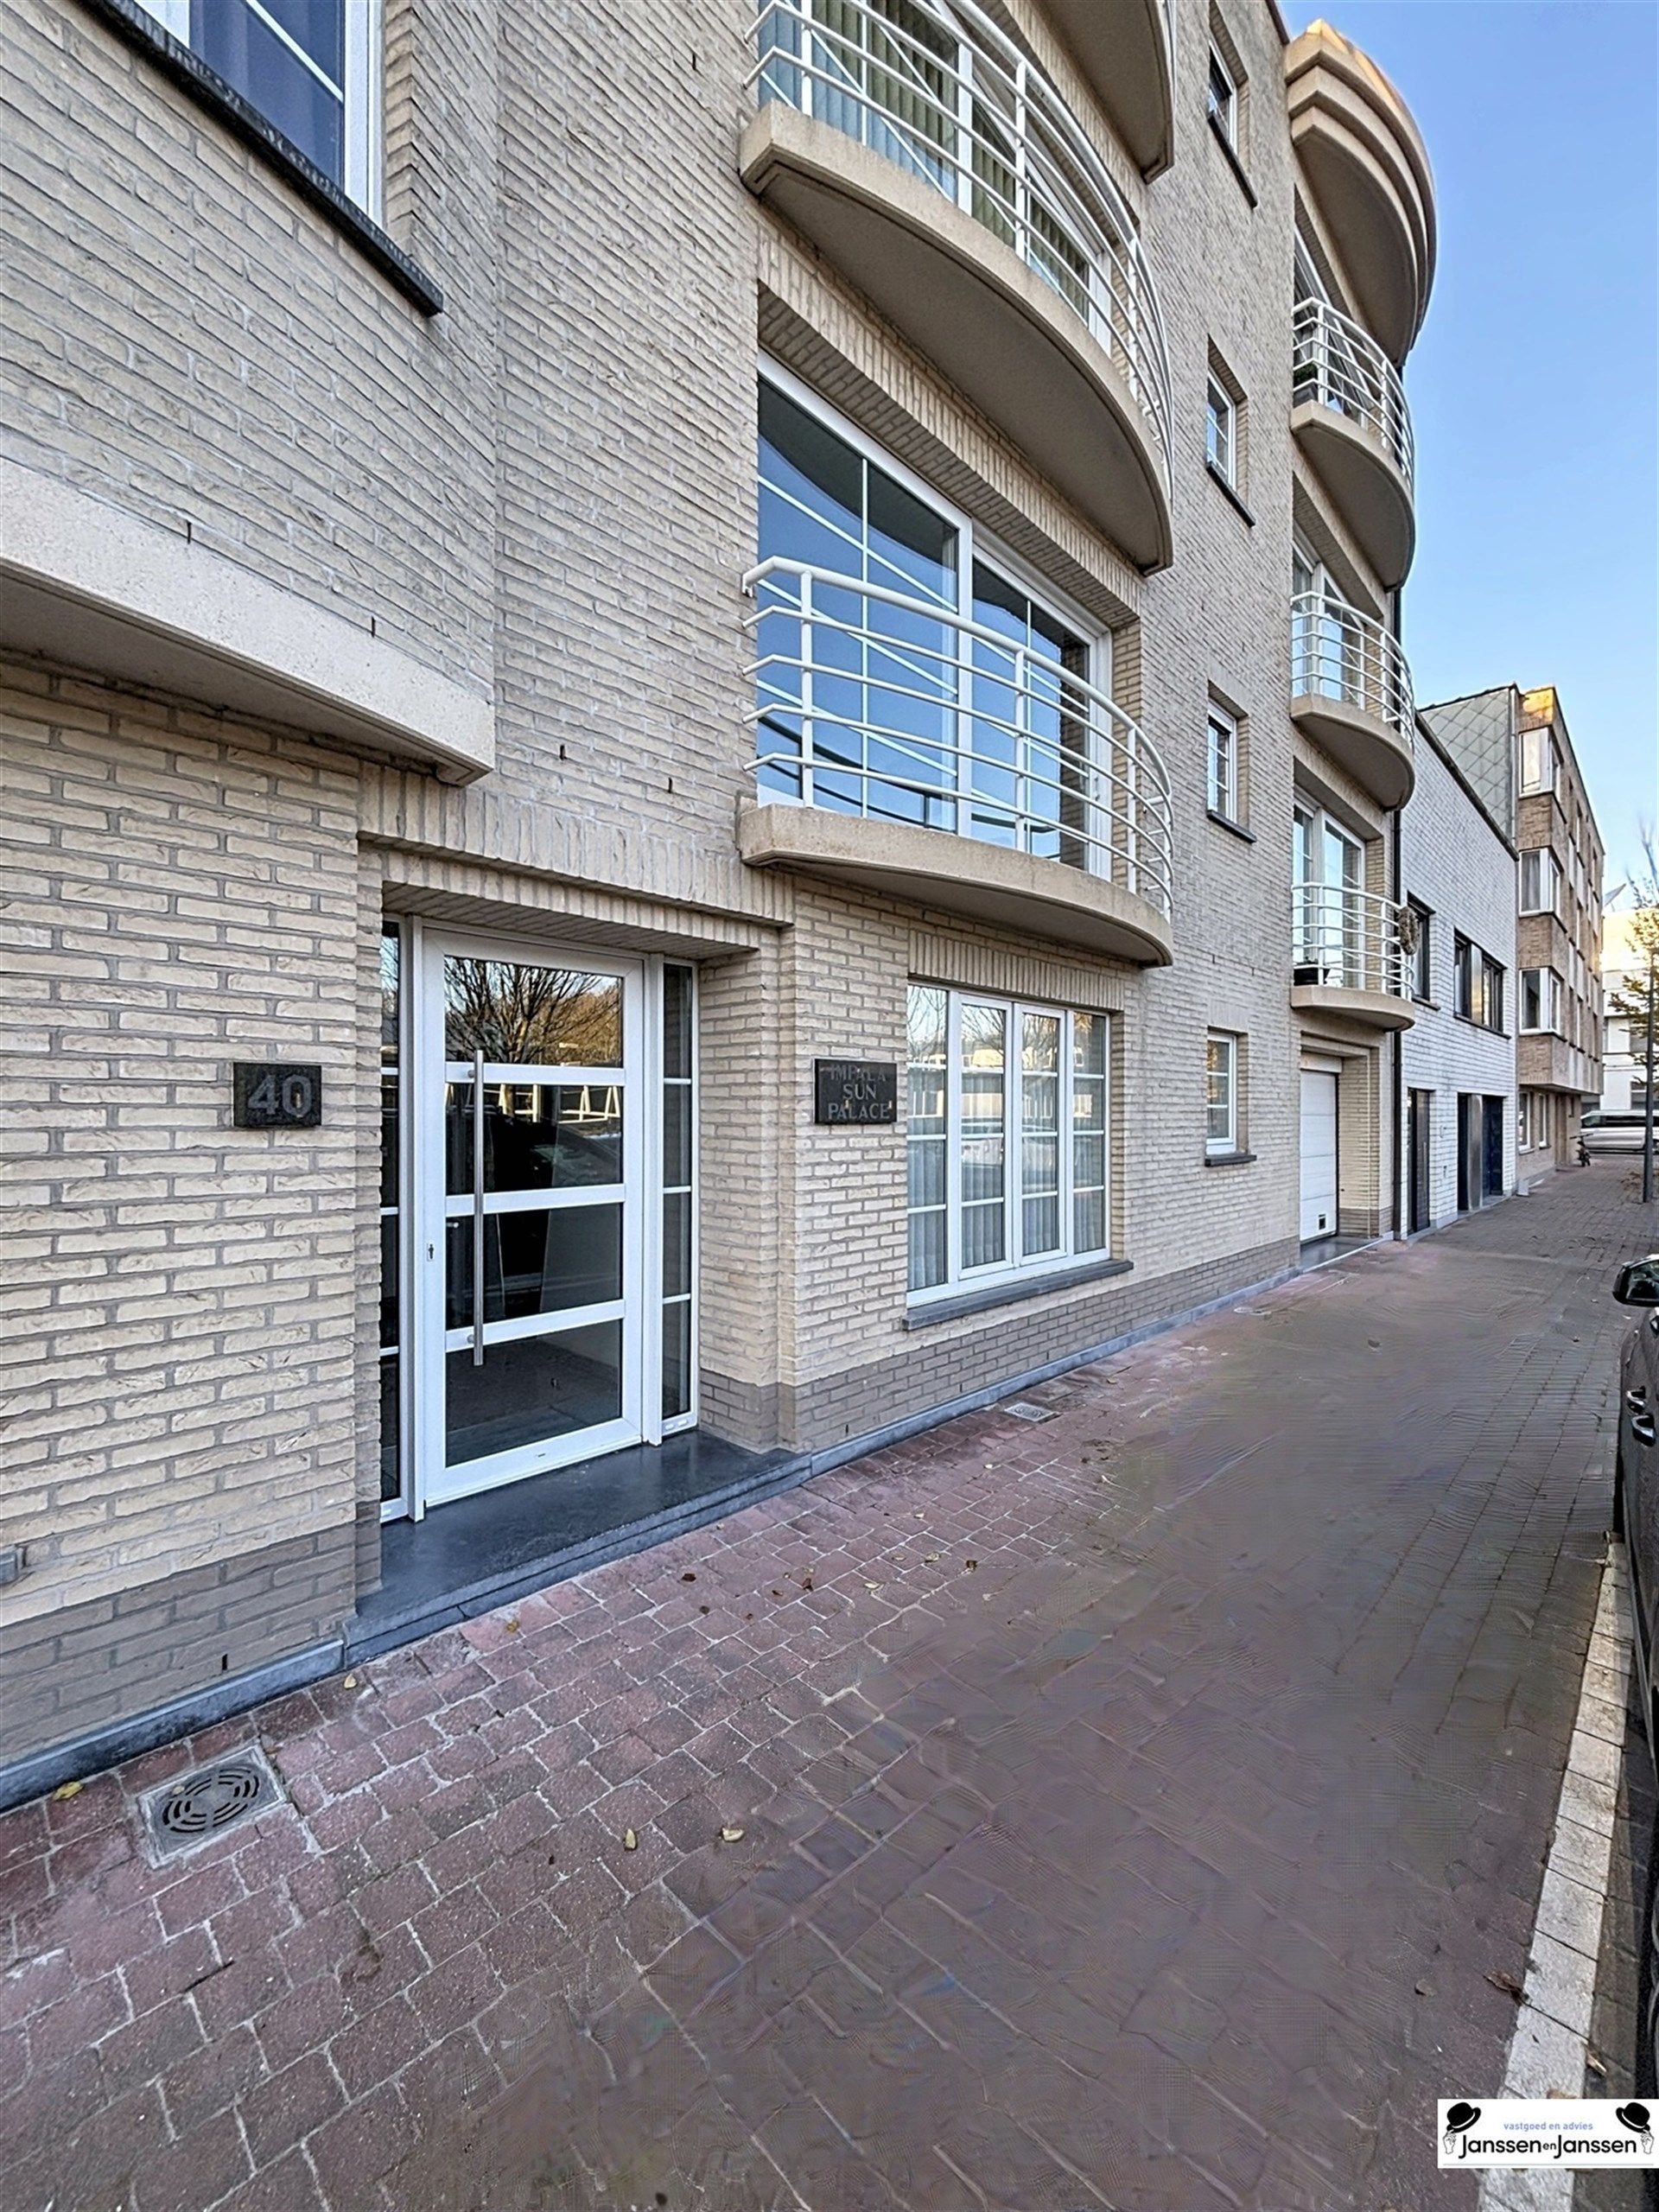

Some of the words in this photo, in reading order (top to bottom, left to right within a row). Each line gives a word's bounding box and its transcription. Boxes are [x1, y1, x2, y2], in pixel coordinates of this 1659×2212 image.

[830, 1064, 887, 1082] IMPALA
[247, 1074, 312, 1118] 40
[842, 1084, 877, 1100] SUN
[828, 1103, 891, 1120] PALACE
